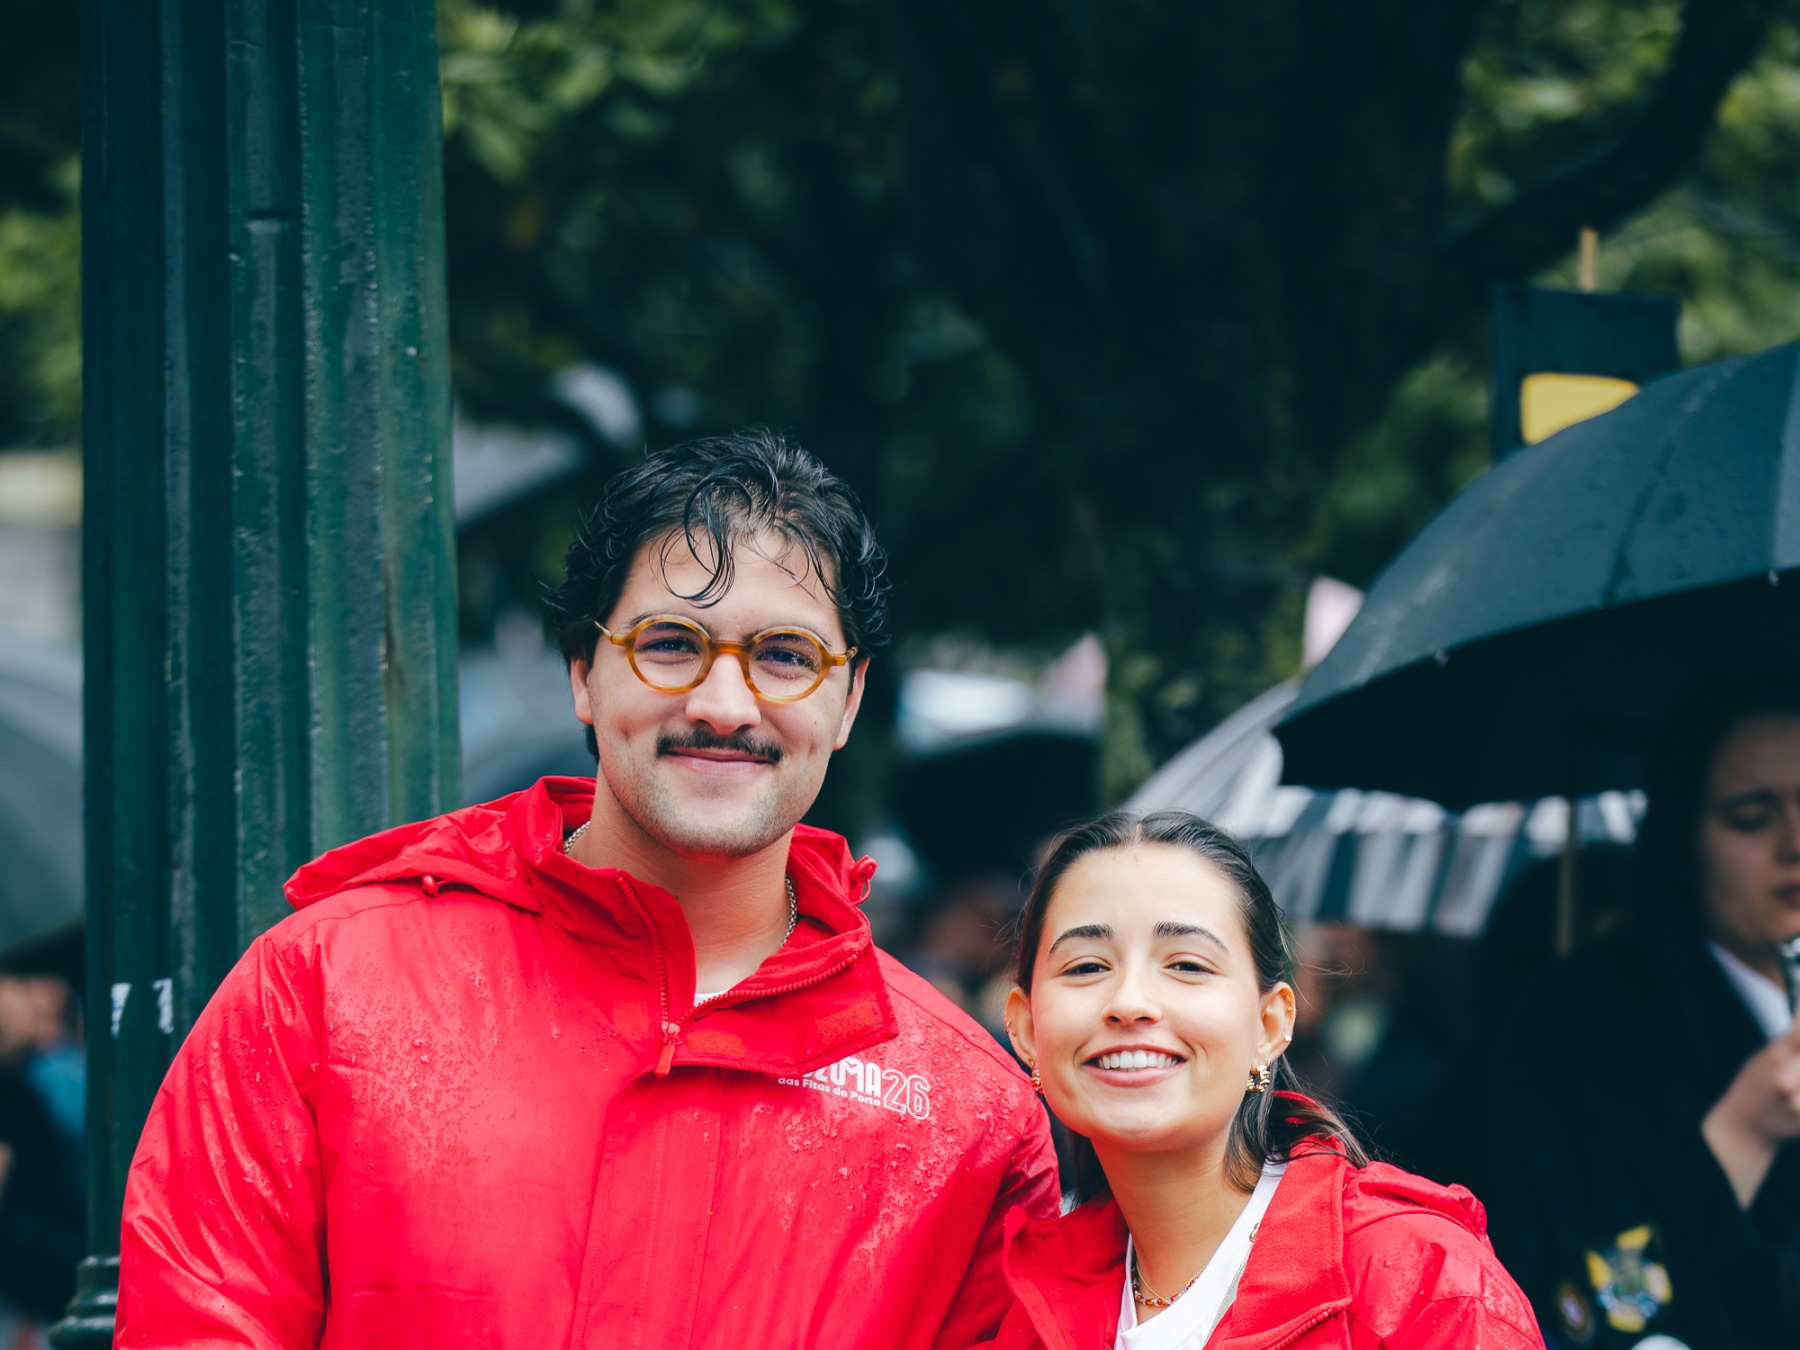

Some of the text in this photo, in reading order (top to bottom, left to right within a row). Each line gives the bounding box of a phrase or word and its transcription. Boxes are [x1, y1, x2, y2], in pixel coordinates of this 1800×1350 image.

[777, 1077, 881, 1106] das Fitas do Porto
